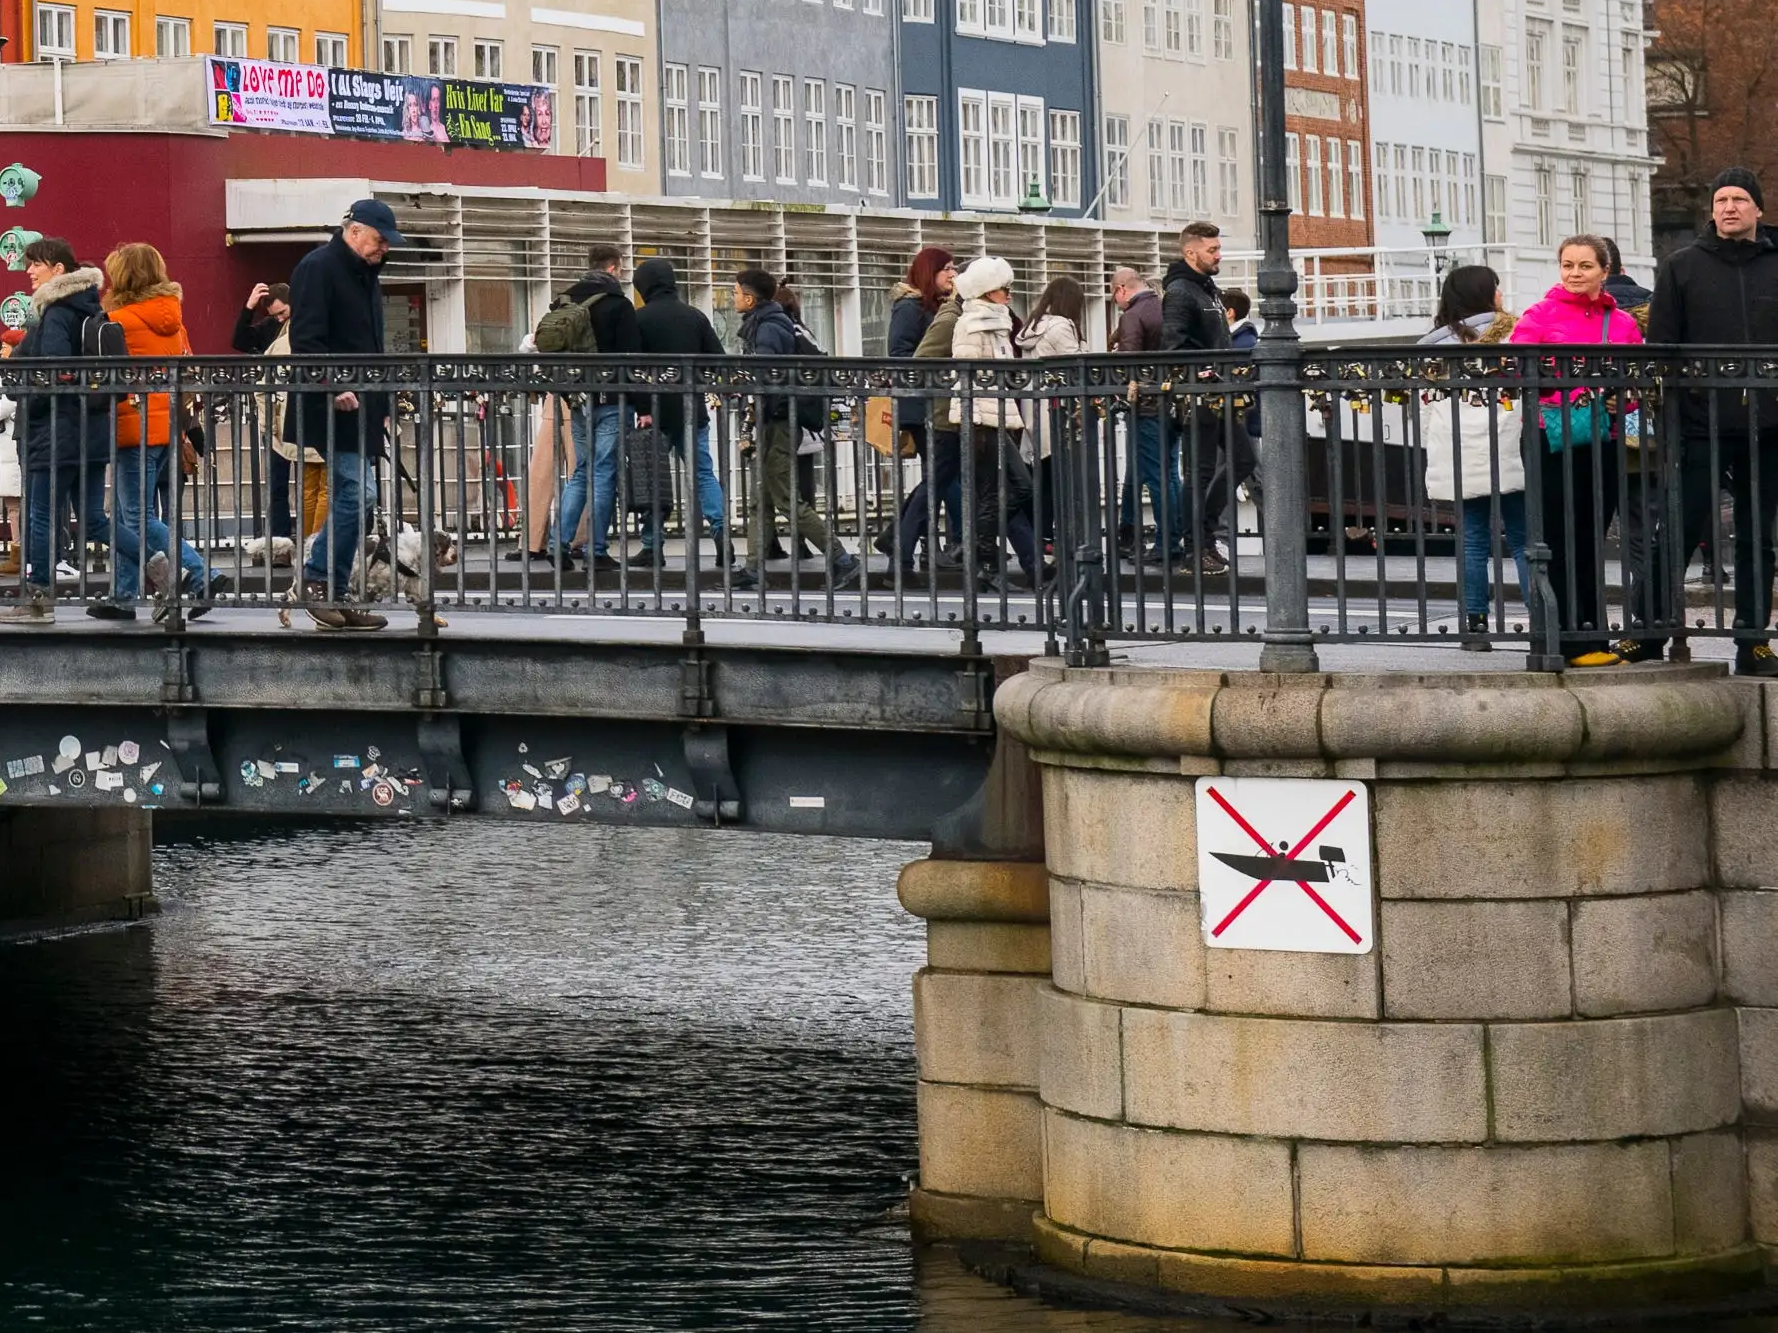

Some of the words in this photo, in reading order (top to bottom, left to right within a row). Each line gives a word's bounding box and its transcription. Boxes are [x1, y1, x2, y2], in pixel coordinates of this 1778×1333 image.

[306, 69, 325, 99] DO
[338, 74, 352, 97] Al
[352, 74, 383, 104] Slags
[383, 78, 404, 107] Vejr
[445, 84, 466, 110] Hvis
[466, 85, 488, 112] Livet
[489, 87, 504, 113] Var
[458, 113, 472, 139] En
